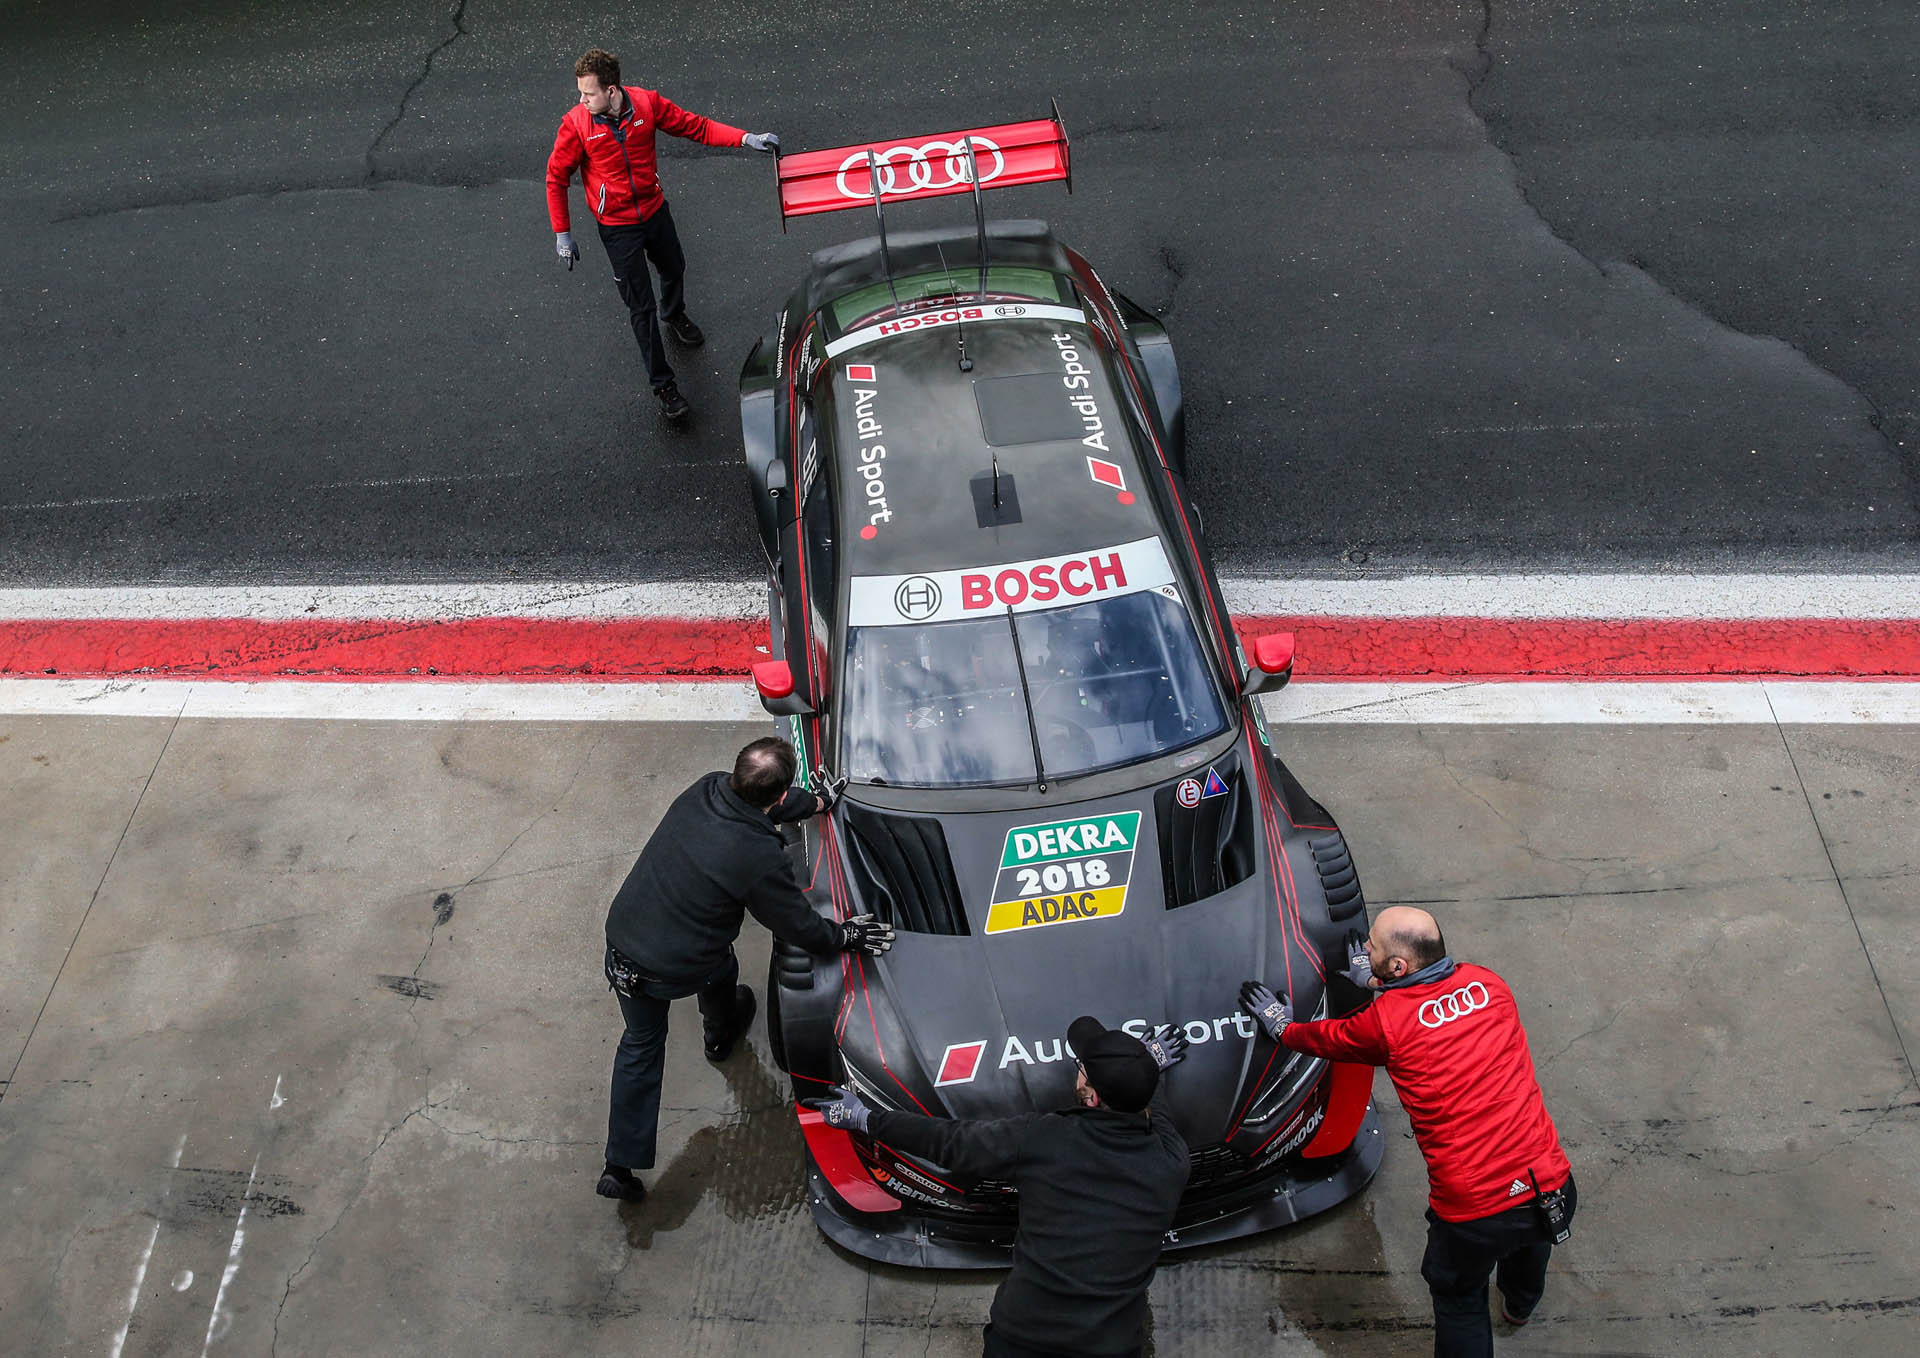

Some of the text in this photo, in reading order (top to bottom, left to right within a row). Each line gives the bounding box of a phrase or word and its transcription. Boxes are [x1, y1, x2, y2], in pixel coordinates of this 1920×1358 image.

[879, 308, 984, 335] BOSCH
[1051, 332, 1110, 452] Audi Sport
[854, 389, 893, 526] Audi Sport
[960, 552, 1128, 610] BOSCH
[1184, 786, 1196, 801] E
[1014, 819, 1129, 860] DEKRA
[1016, 859, 1111, 896] 2018
[1021, 892, 1098, 926] ADAC
[999, 1011, 1254, 1069] Au Sort
